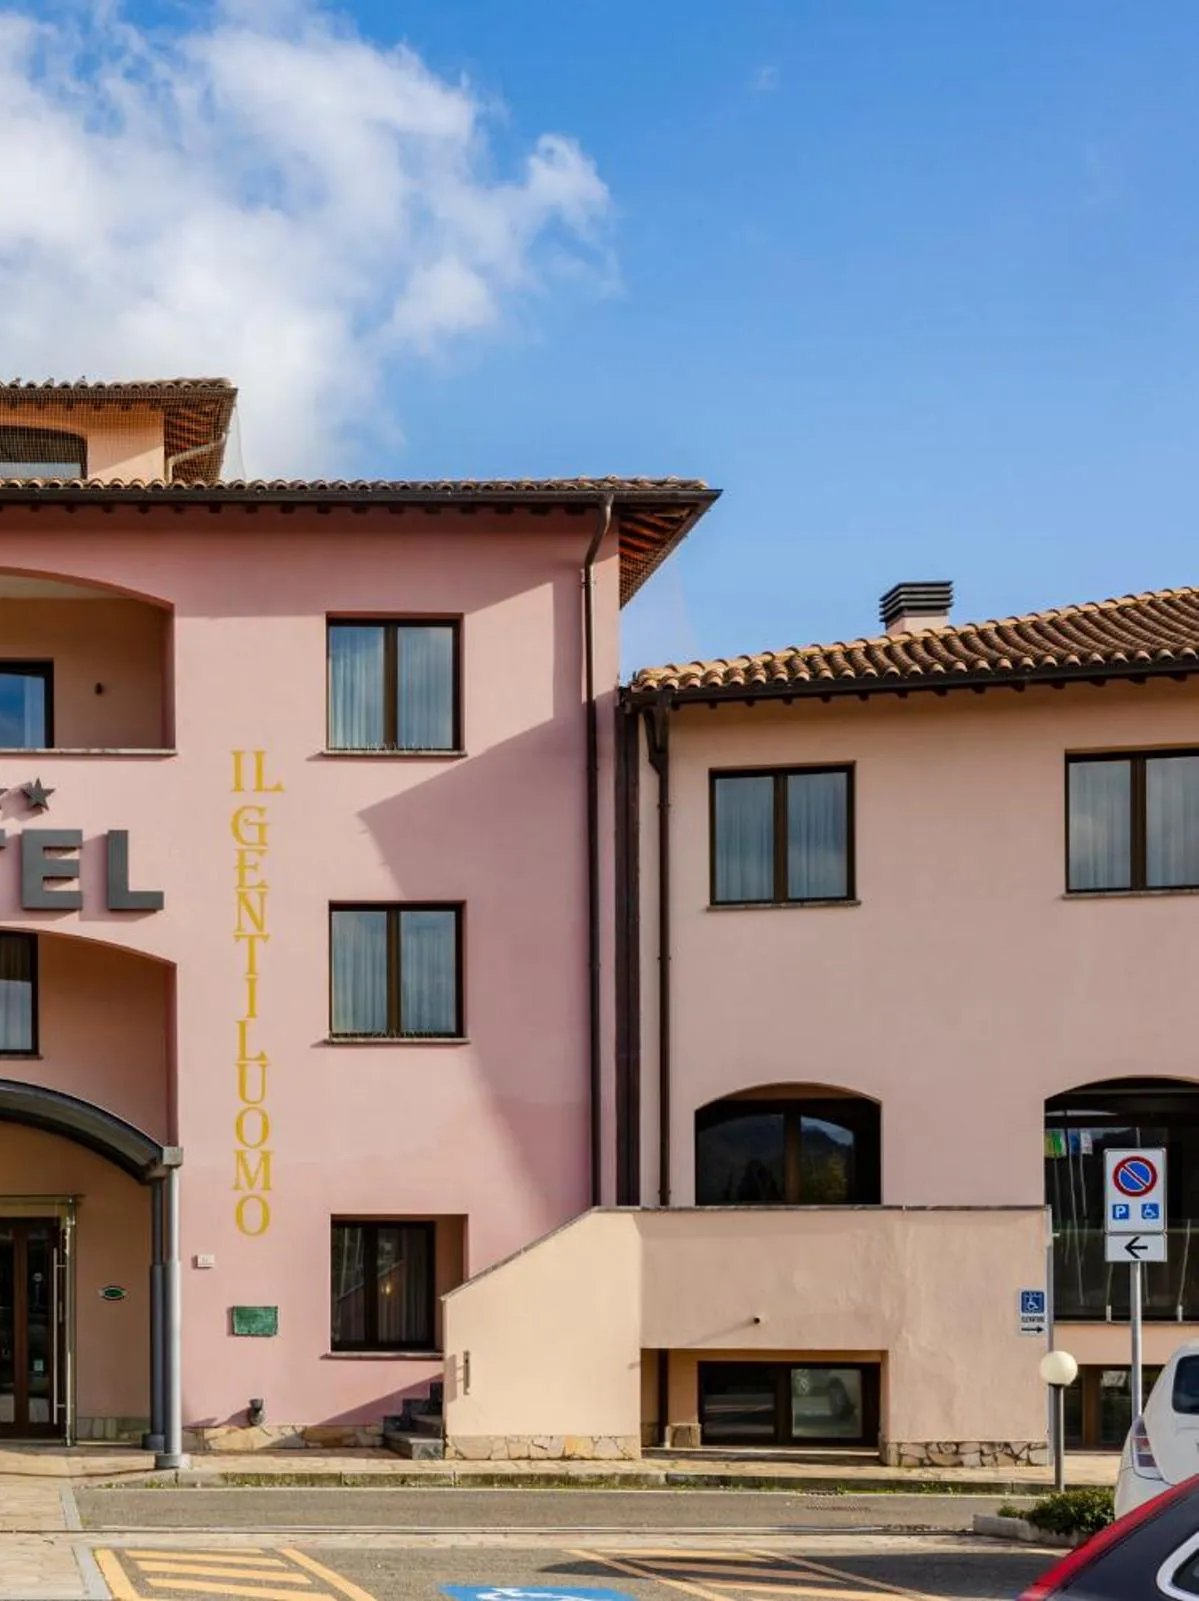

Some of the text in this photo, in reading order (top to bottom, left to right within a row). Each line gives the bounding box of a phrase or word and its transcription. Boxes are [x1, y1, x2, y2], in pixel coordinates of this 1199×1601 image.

[231, 750, 285, 1236] IL GENTILUOMO
[1115, 1205, 1127, 1219] P
